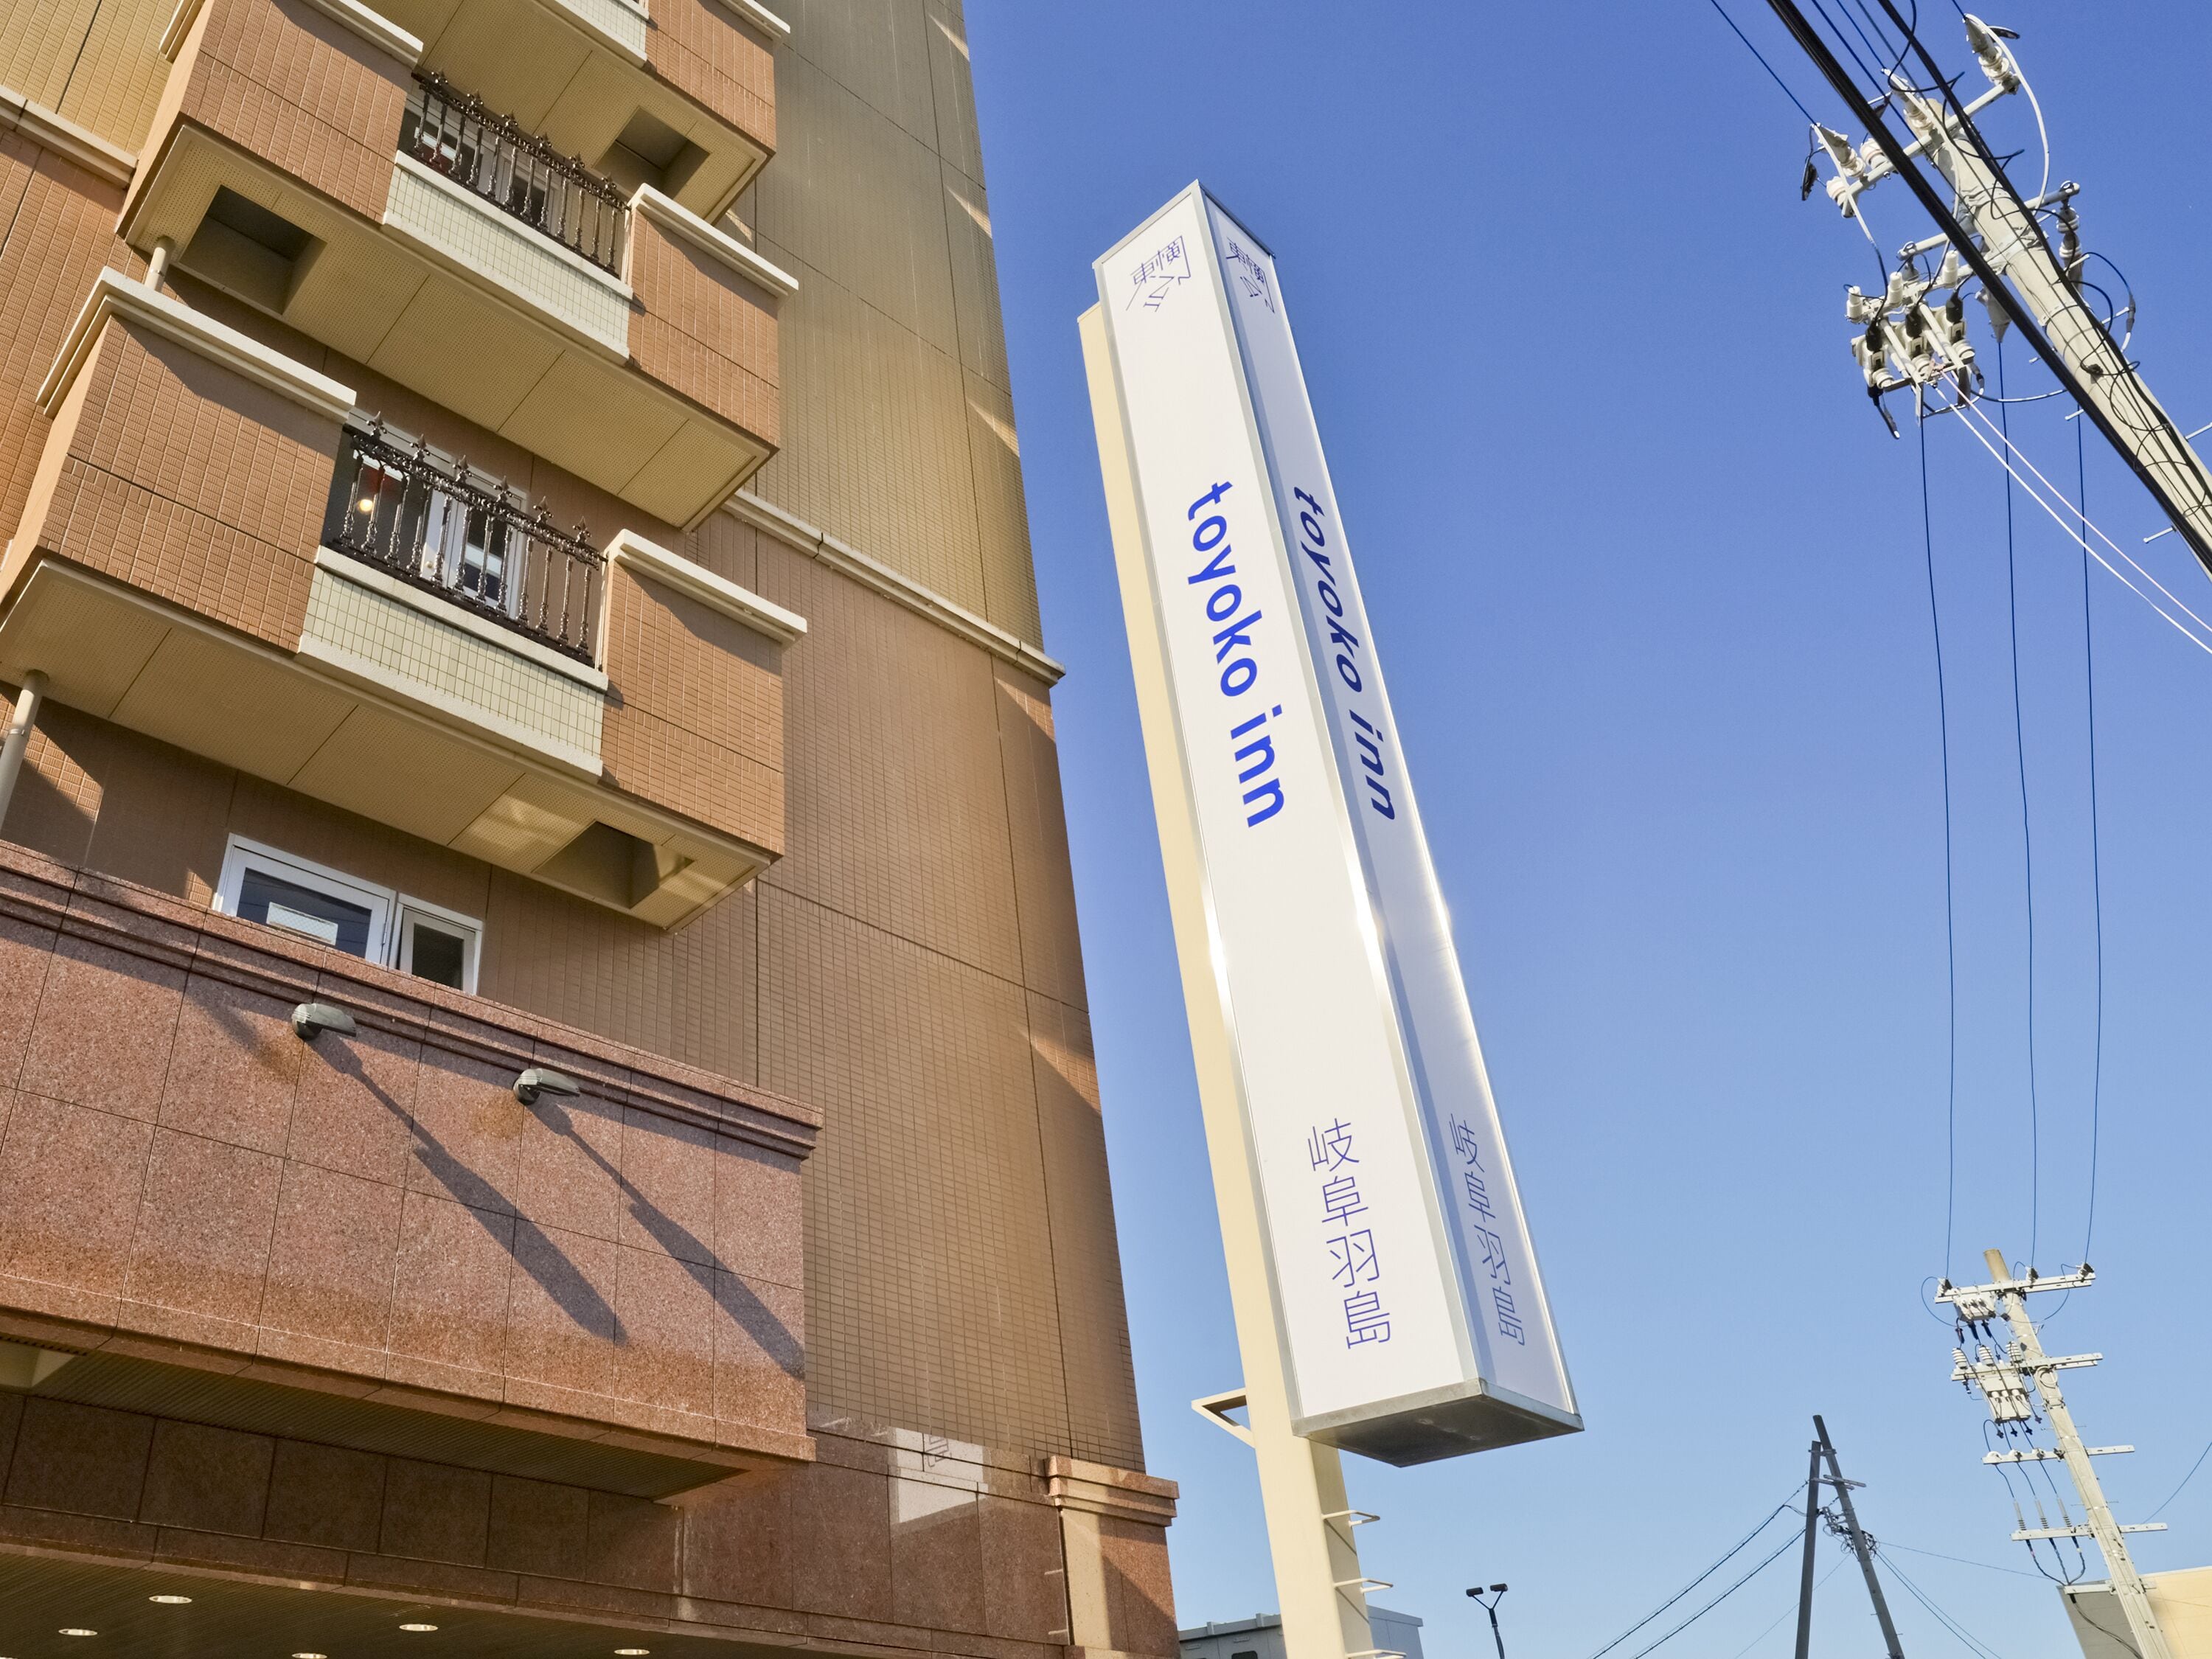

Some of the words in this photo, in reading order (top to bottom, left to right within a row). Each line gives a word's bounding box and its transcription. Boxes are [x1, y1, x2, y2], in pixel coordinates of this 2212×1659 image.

[1188, 481, 1262, 697] toyoko
[1231, 704, 1284, 827] inn
[1294, 487, 1362, 692] toyoko
[1349, 709, 1395, 820] inn
[1308, 1118, 1391, 1349] 岐阜羽島
[1449, 1113, 1525, 1346] 岐阜羽島
